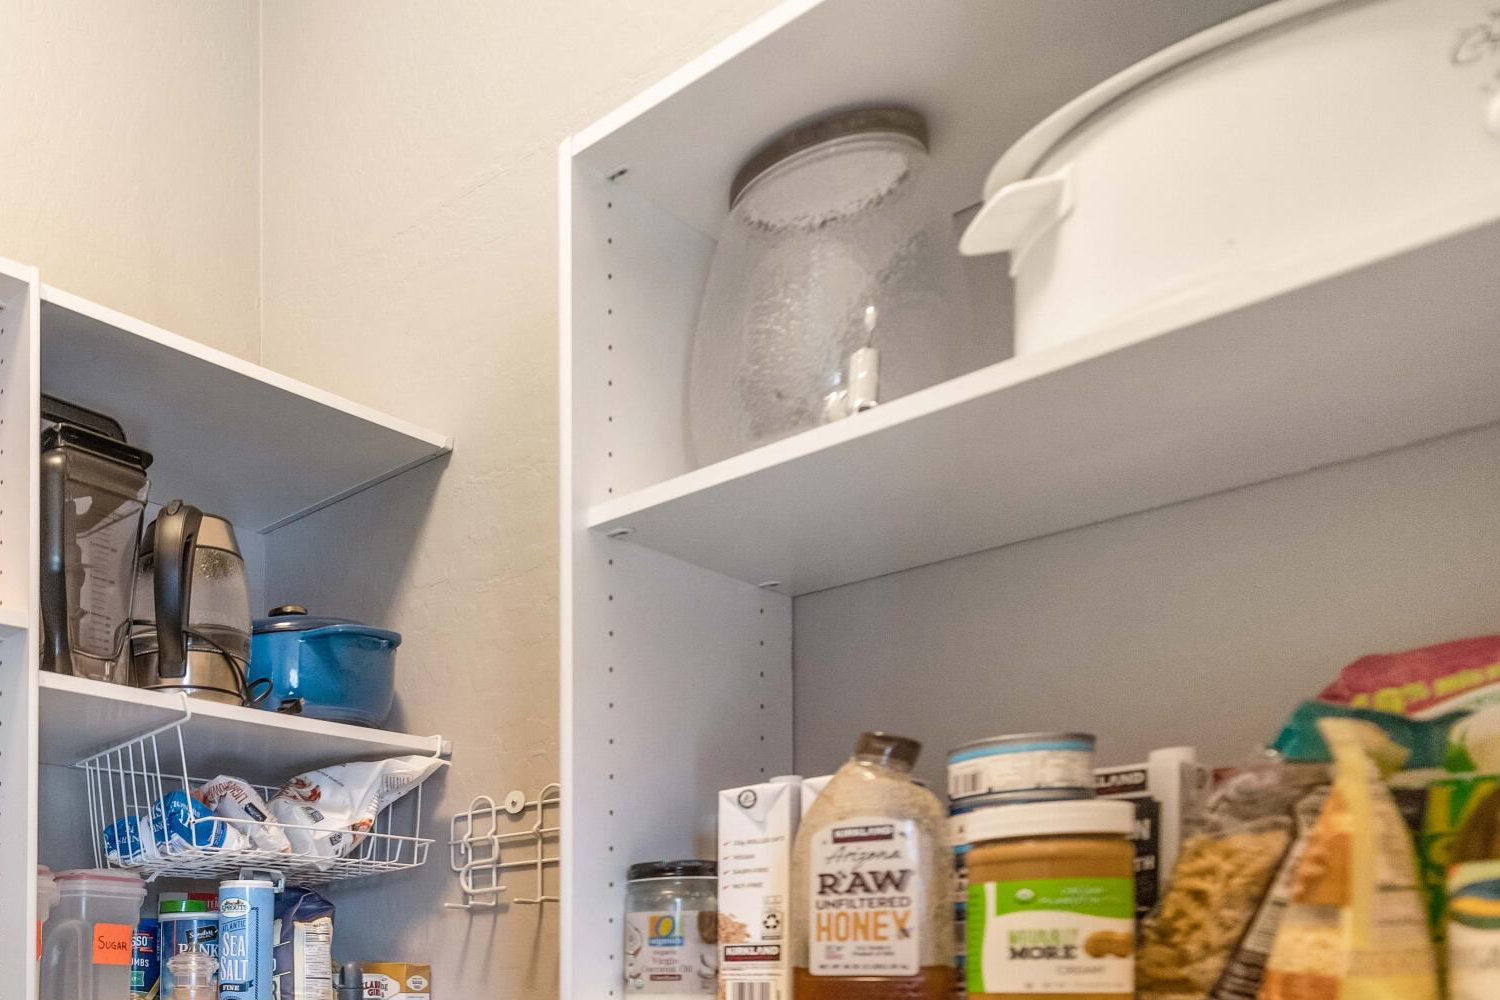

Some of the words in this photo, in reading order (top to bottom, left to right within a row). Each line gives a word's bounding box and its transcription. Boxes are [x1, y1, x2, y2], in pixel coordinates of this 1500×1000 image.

[817, 868, 914, 896] RAW
[221, 904, 248, 912] SPROUTS
[815, 896, 911, 910] UNFILTERED
[222, 919, 246, 931] ATLANTIC
[815, 910, 911, 943] HONEY
[222, 931, 247, 957] SEA
[220, 956, 249, 981] SALT
[222, 984, 240, 992] FINE
